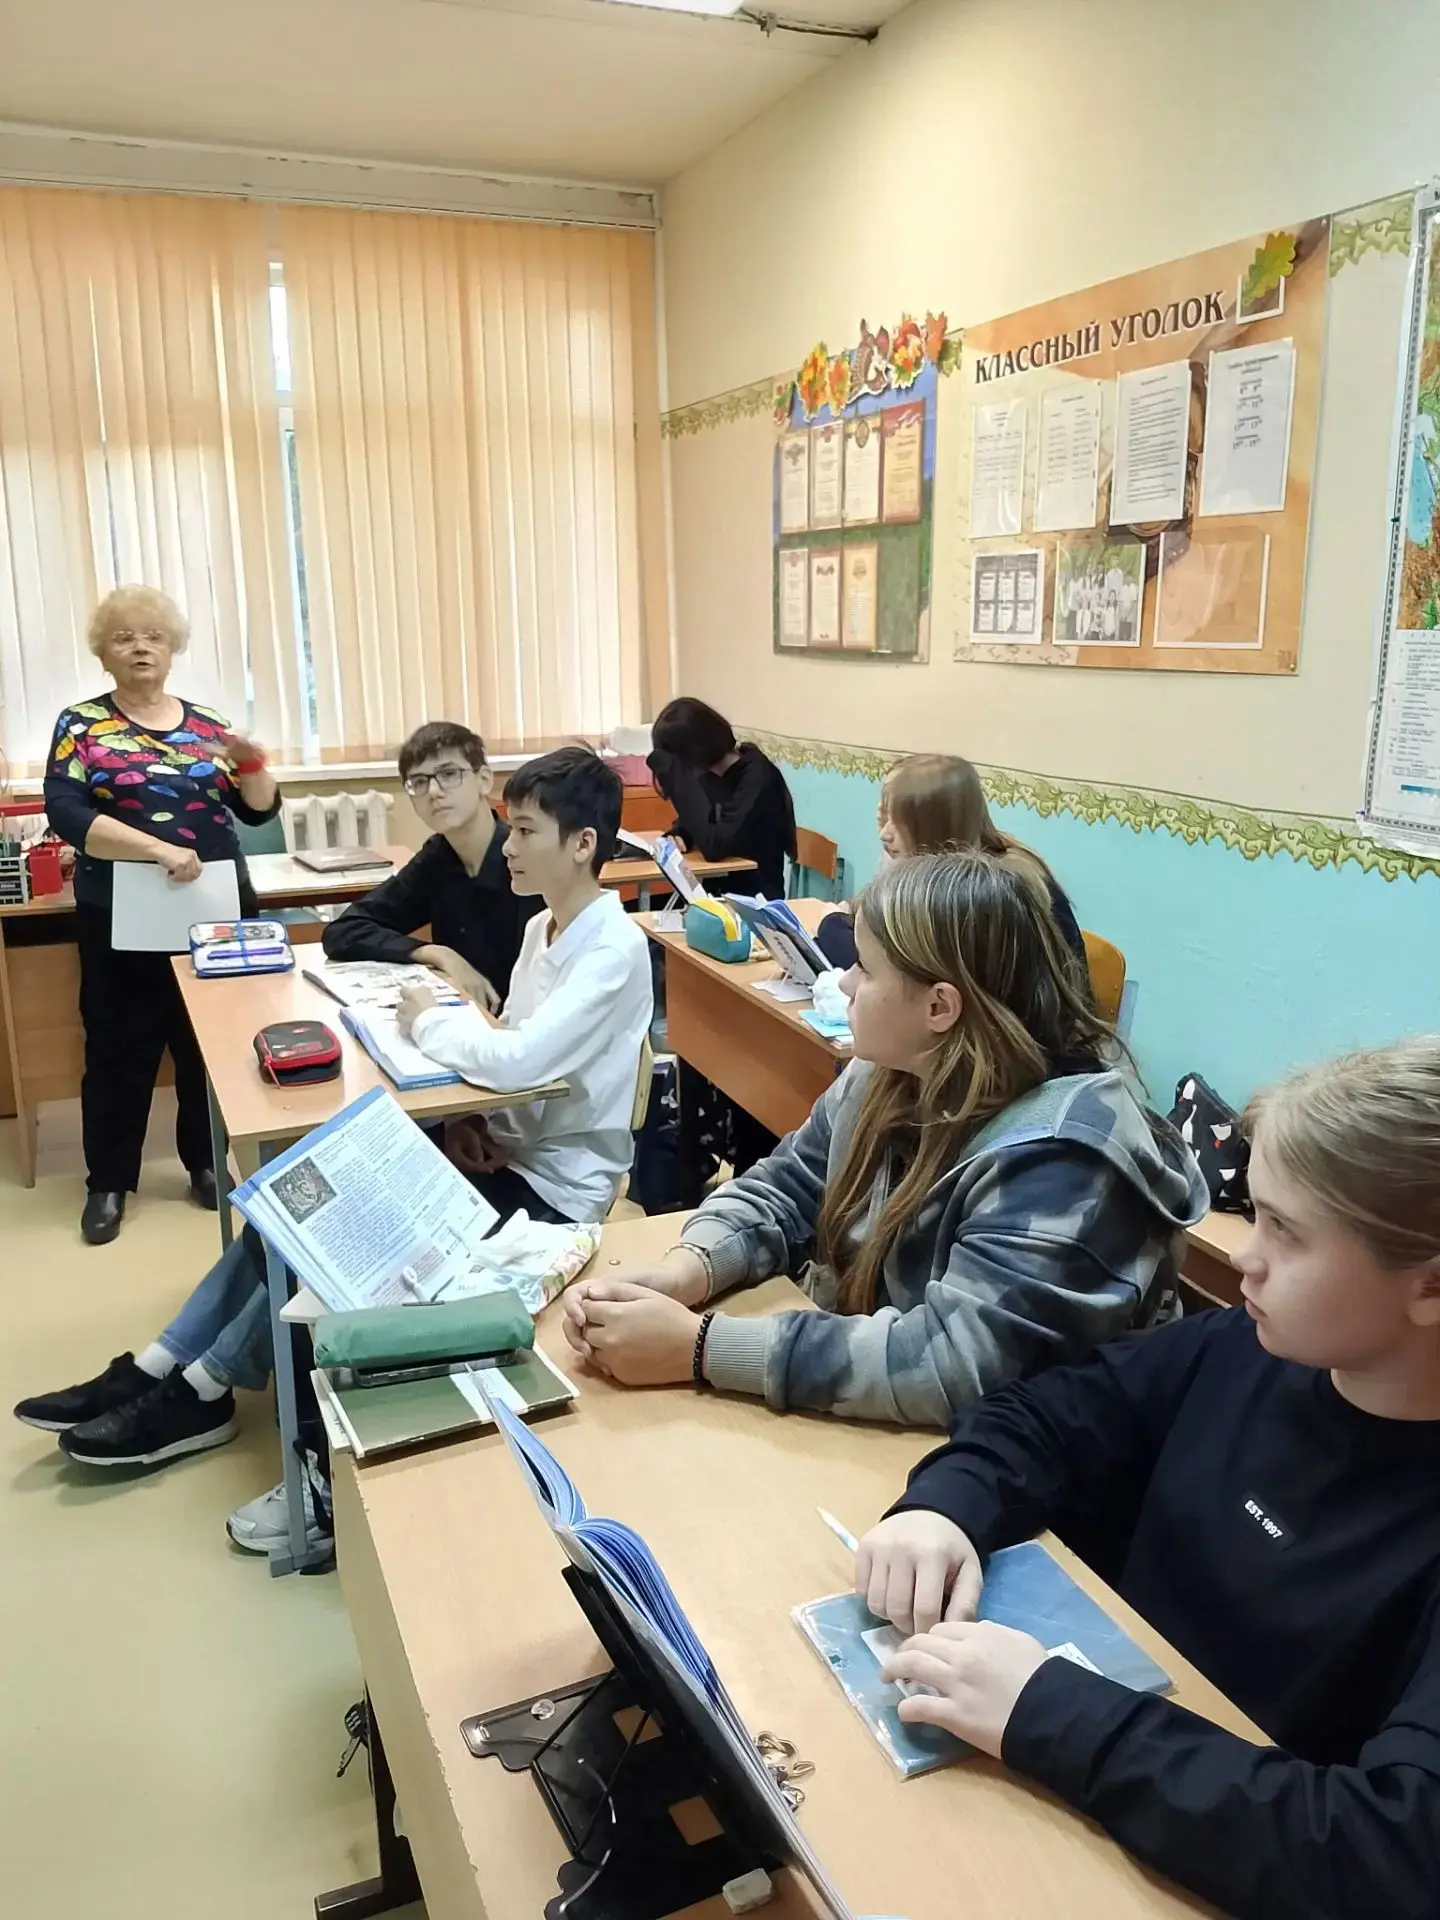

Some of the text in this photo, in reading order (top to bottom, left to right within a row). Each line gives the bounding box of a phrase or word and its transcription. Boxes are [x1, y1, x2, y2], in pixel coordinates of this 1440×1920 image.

[975, 291, 1224, 384] КЛАССНЫЙ УГОЛОК
[1244, 1499, 1283, 1539] EST. 1997
